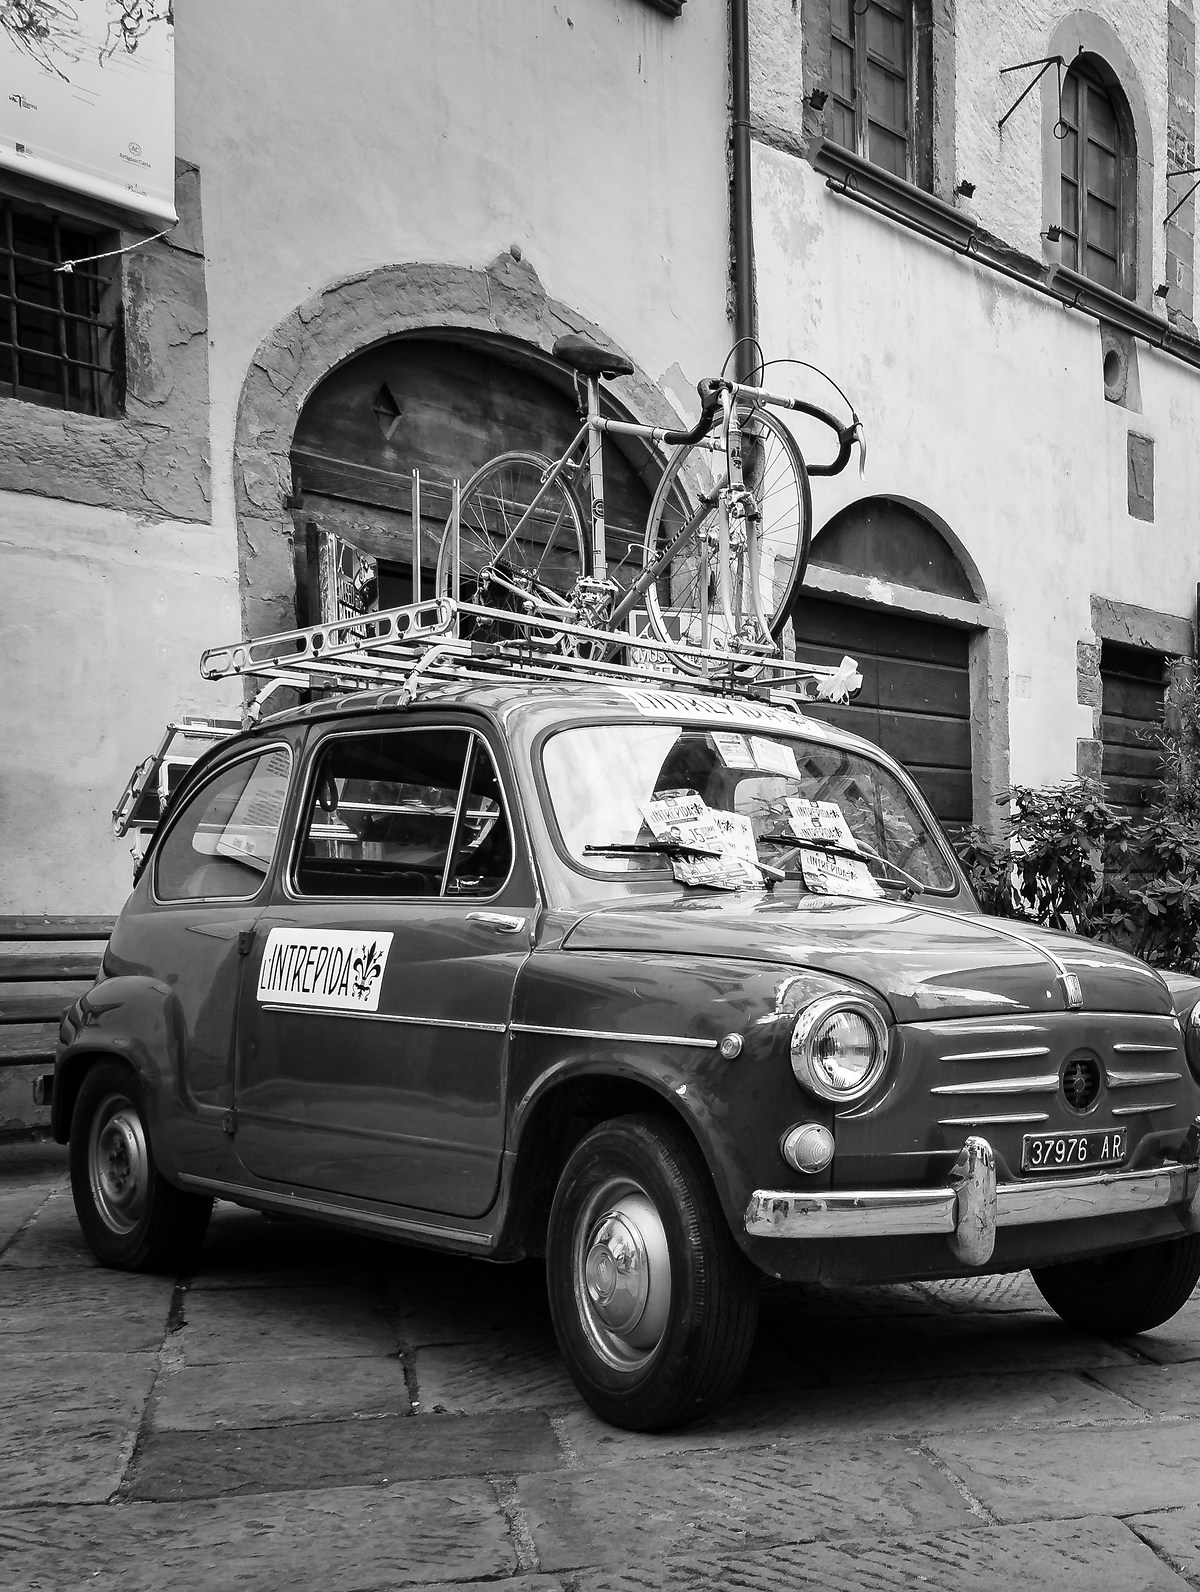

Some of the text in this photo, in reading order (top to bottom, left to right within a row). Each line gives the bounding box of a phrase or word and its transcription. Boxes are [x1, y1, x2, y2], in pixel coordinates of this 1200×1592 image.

[260, 944, 354, 997] L'INTREPIDA
[1031, 1134, 1121, 1165] 37976 AR
